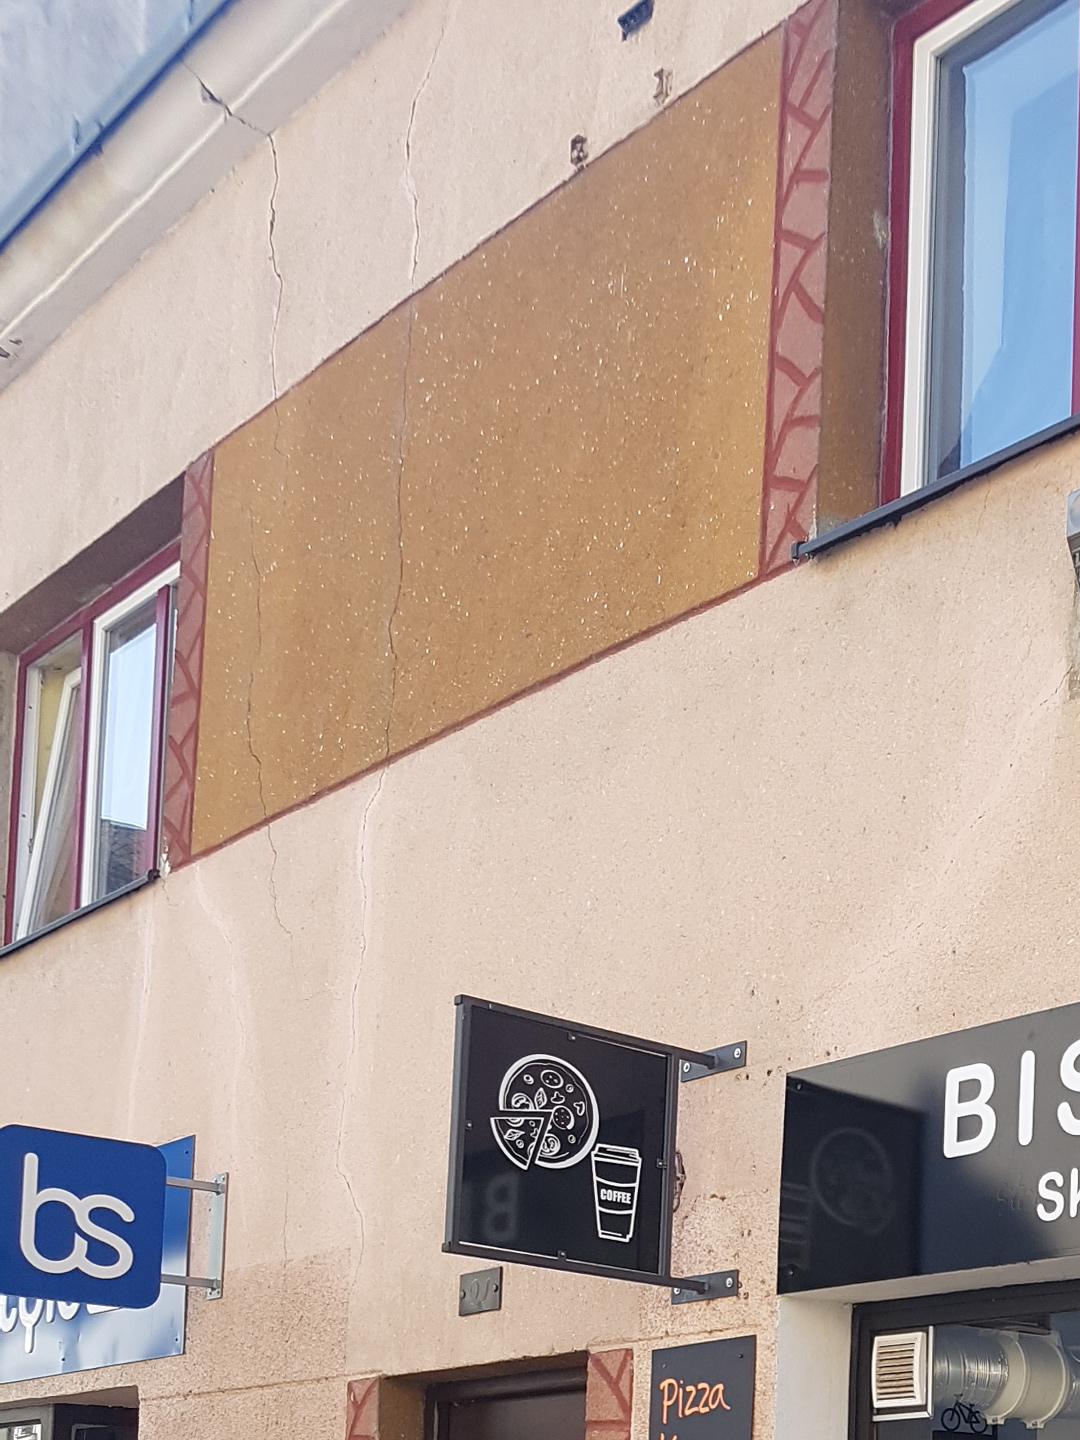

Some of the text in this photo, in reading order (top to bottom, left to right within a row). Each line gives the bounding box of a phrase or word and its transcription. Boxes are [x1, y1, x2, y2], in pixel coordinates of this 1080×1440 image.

[20, 1152, 135, 1280] bs
[600, 1188, 632, 1204] COFFEE
[659, 1377, 731, 1424] Pizza
